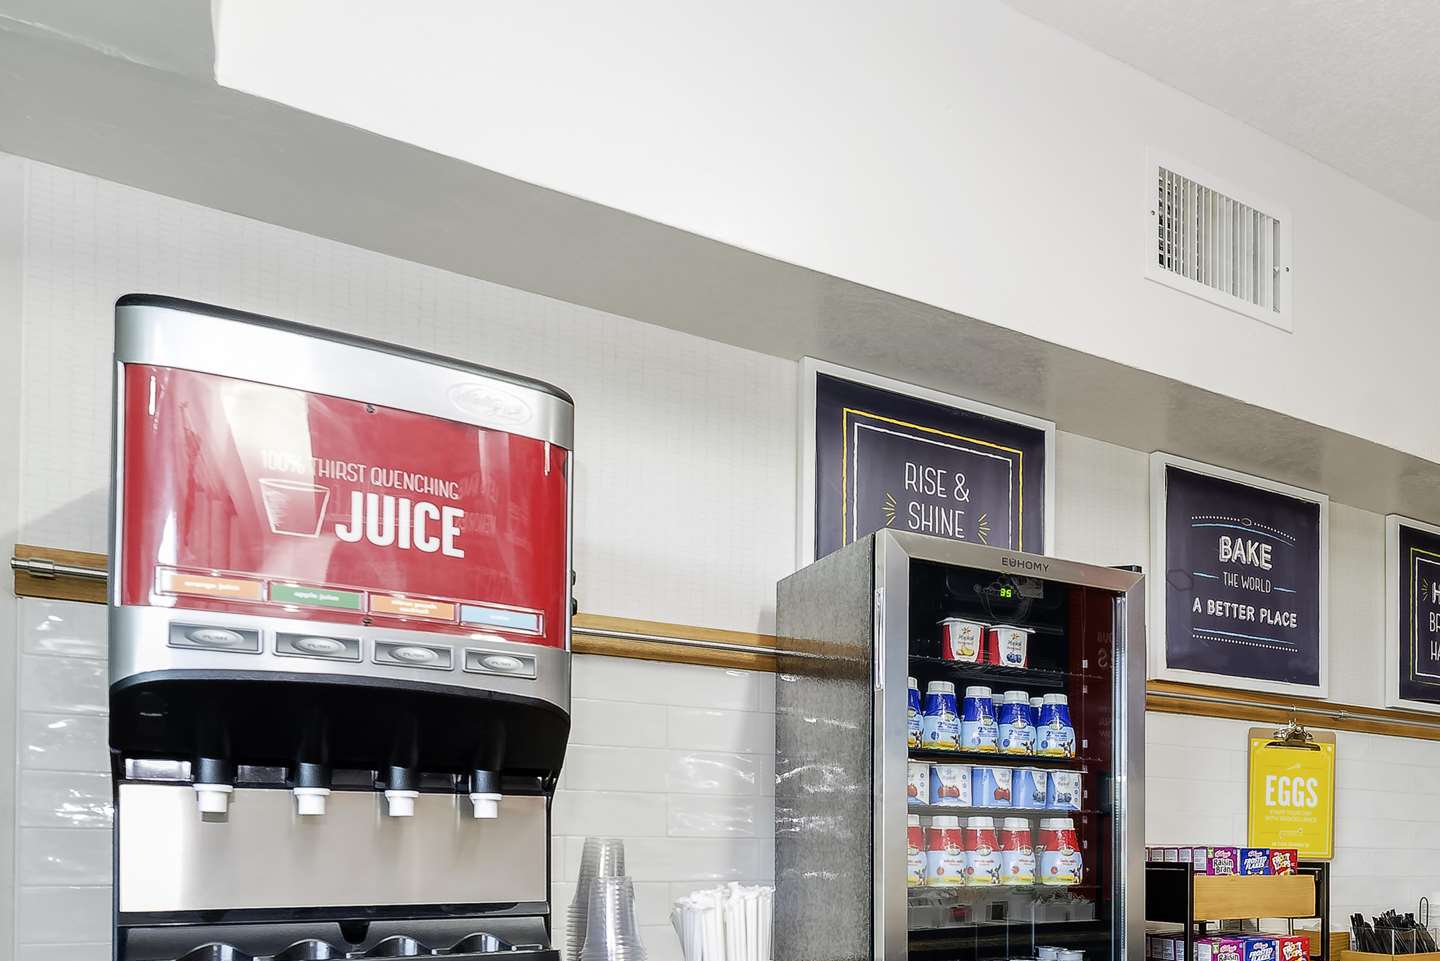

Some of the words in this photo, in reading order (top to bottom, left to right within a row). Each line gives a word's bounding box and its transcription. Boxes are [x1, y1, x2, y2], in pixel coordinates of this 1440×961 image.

[312, 457, 367, 483] THIRST
[370, 466, 459, 500] QUENCHING
[905, 462, 948, 498] RISE
[954, 473, 970, 503] &
[335, 490, 465, 559] JUICE
[908, 501, 965, 539] SHINE
[1002, 557, 1049, 573] EUHOMY
[1219, 535, 1272, 571] BAKE
[1223, 571, 1239, 588] THE
[1241, 575, 1271, 593] WORLD
[1192, 597, 1202, 613] A
[1207, 599, 1255, 622] BETTER
[1260, 608, 1297, 628] PLACE
[1265, 775, 1318, 808] EGGS
[1213, 859, 1233, 867] Raisin
[1215, 866, 1232, 874] Bran
[1219, 953, 1240, 961] Raisin
